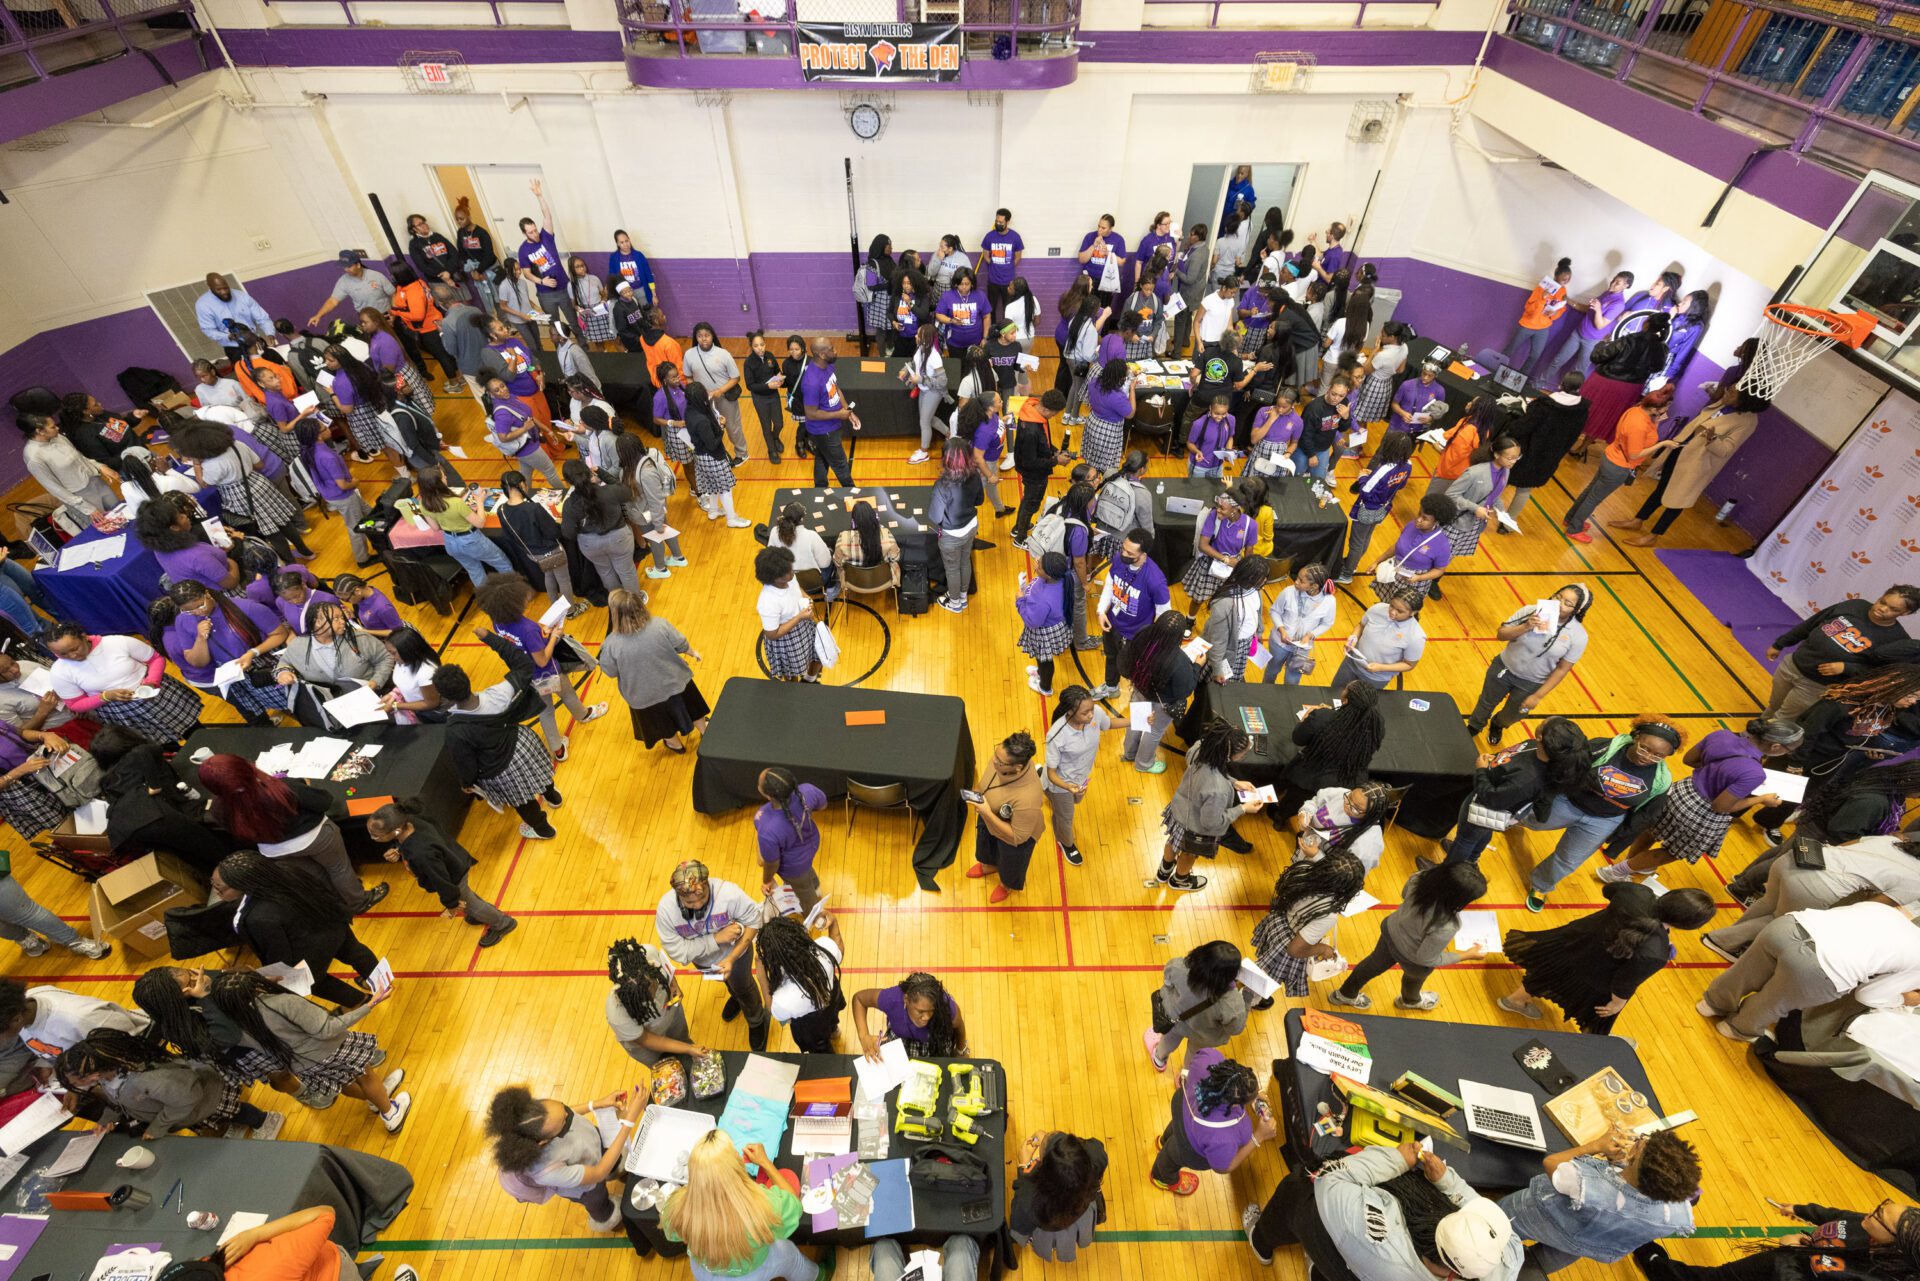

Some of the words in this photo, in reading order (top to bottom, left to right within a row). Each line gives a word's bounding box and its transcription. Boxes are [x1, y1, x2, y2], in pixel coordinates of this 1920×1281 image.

[844, 23, 871, 37] BLSYW
[872, 23, 912, 37] ATHLETICS
[800, 43, 868, 70] PROTECT
[898, 44, 927, 70] THE
[929, 44, 959, 70] DEN
[423, 64, 446, 82] EXIT
[1269, 65, 1293, 82] EXIT
[952, 303, 977, 311] BLSYW
[991, 356, 1016, 366] BLSY
[1328, 1050, 1350, 1062] Health
[1330, 1059, 1345, 1069] Take
[1346, 1066, 1362, 1075] Let's
